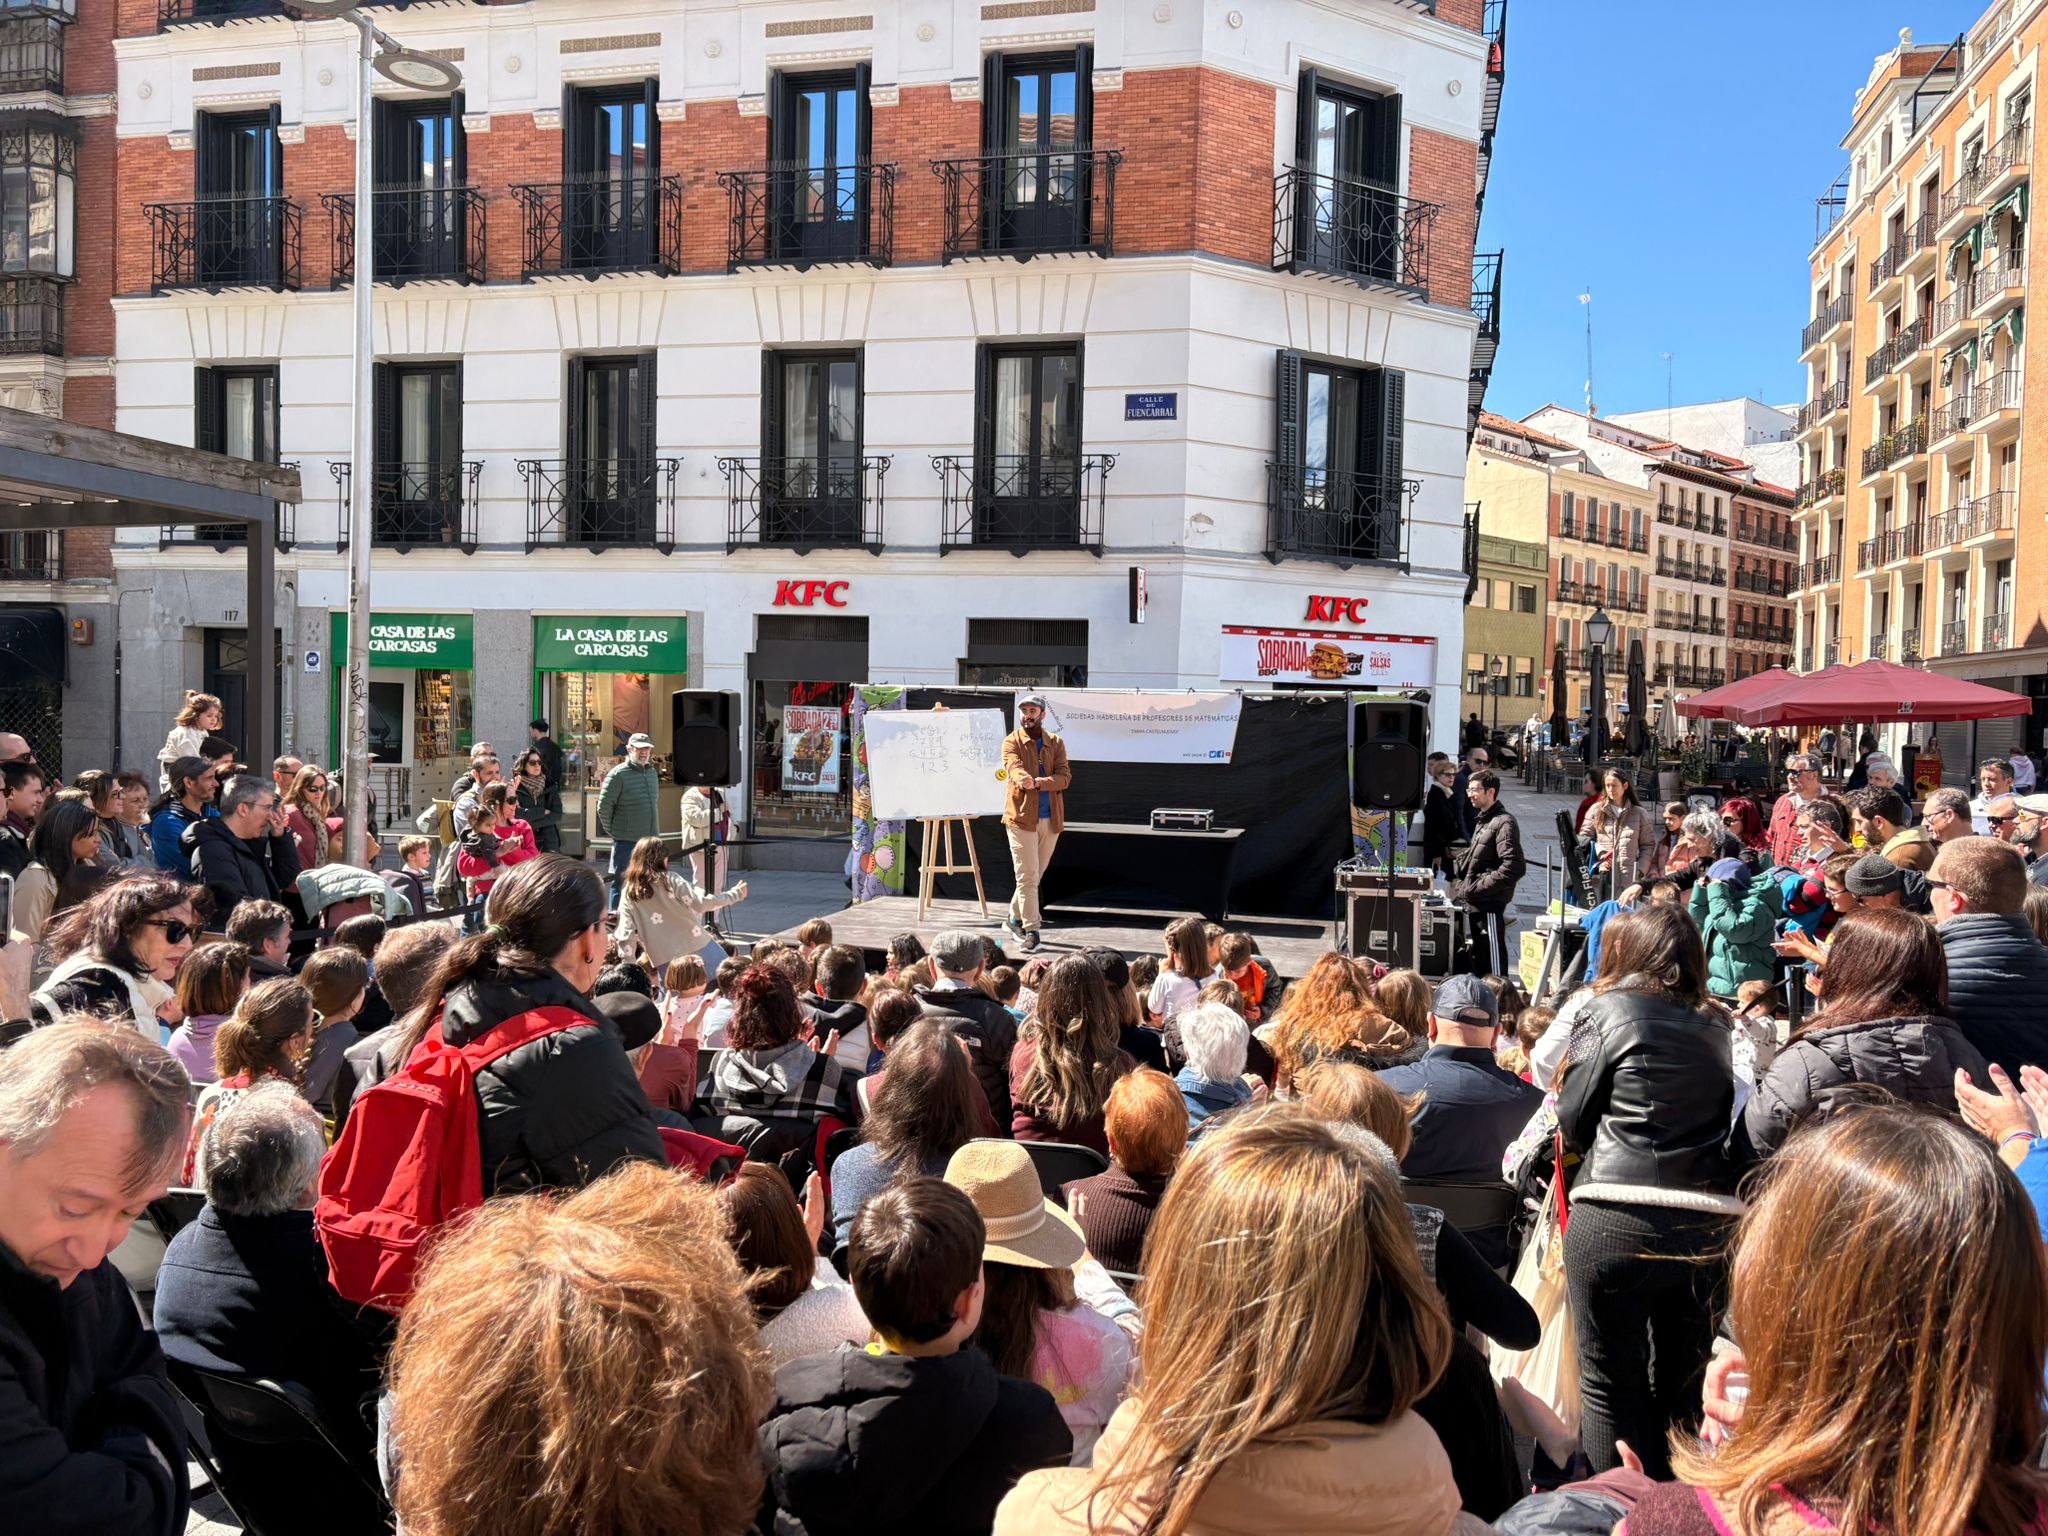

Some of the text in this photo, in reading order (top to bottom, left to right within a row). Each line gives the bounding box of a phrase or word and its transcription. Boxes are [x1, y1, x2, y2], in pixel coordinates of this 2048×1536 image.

[1127, 407, 1175, 418] FUENCARRAL
[772, 580, 849, 607] KFC
[224, 610, 239, 622] 117
[1307, 595, 1369, 624] KFC
[370, 626, 456, 640] CASA DE LAS
[555, 628, 668, 644] LA CASA DE LAS
[368, 639, 437, 653] CARCASAS
[574, 643, 649, 657] CARCASAS
[1257, 639, 1308, 672] SOBRADA
[1369, 657, 1392, 669] SALSAS
[1258, 668, 1278, 676] BBQ
[785, 711, 822, 729] SOBRADA
[1066, 712, 1095, 720] SOCIEDAD
[1097, 712, 1132, 721] MADRILEÑA
[1143, 714, 1183, 722] PROFESORES
[1194, 713, 1239, 722] MATEMÁTICAS
[794, 770, 817, 782] KFC
